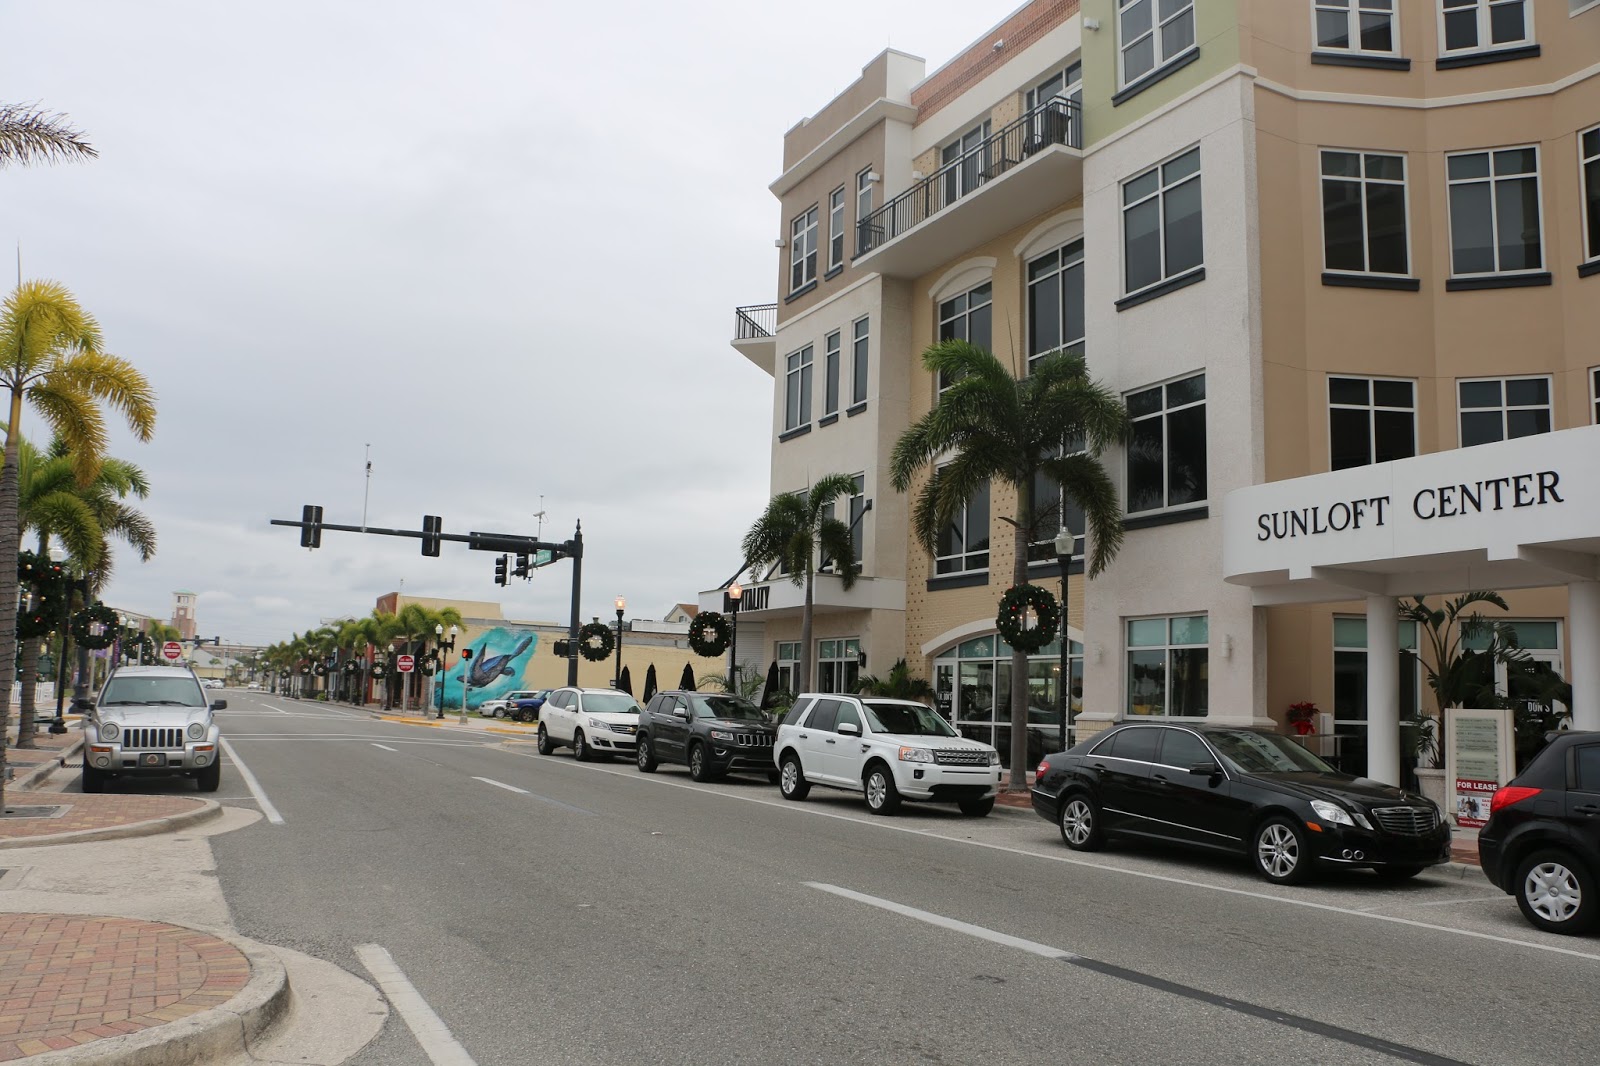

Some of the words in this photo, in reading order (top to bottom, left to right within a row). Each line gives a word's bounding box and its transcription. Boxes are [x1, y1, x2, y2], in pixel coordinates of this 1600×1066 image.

[1257, 495, 1390, 542] SUNLOFT
[1413, 470, 1565, 520] CENTER
[1456, 781, 1472, 789] FOR
[1473, 782, 1498, 791] LEASE
